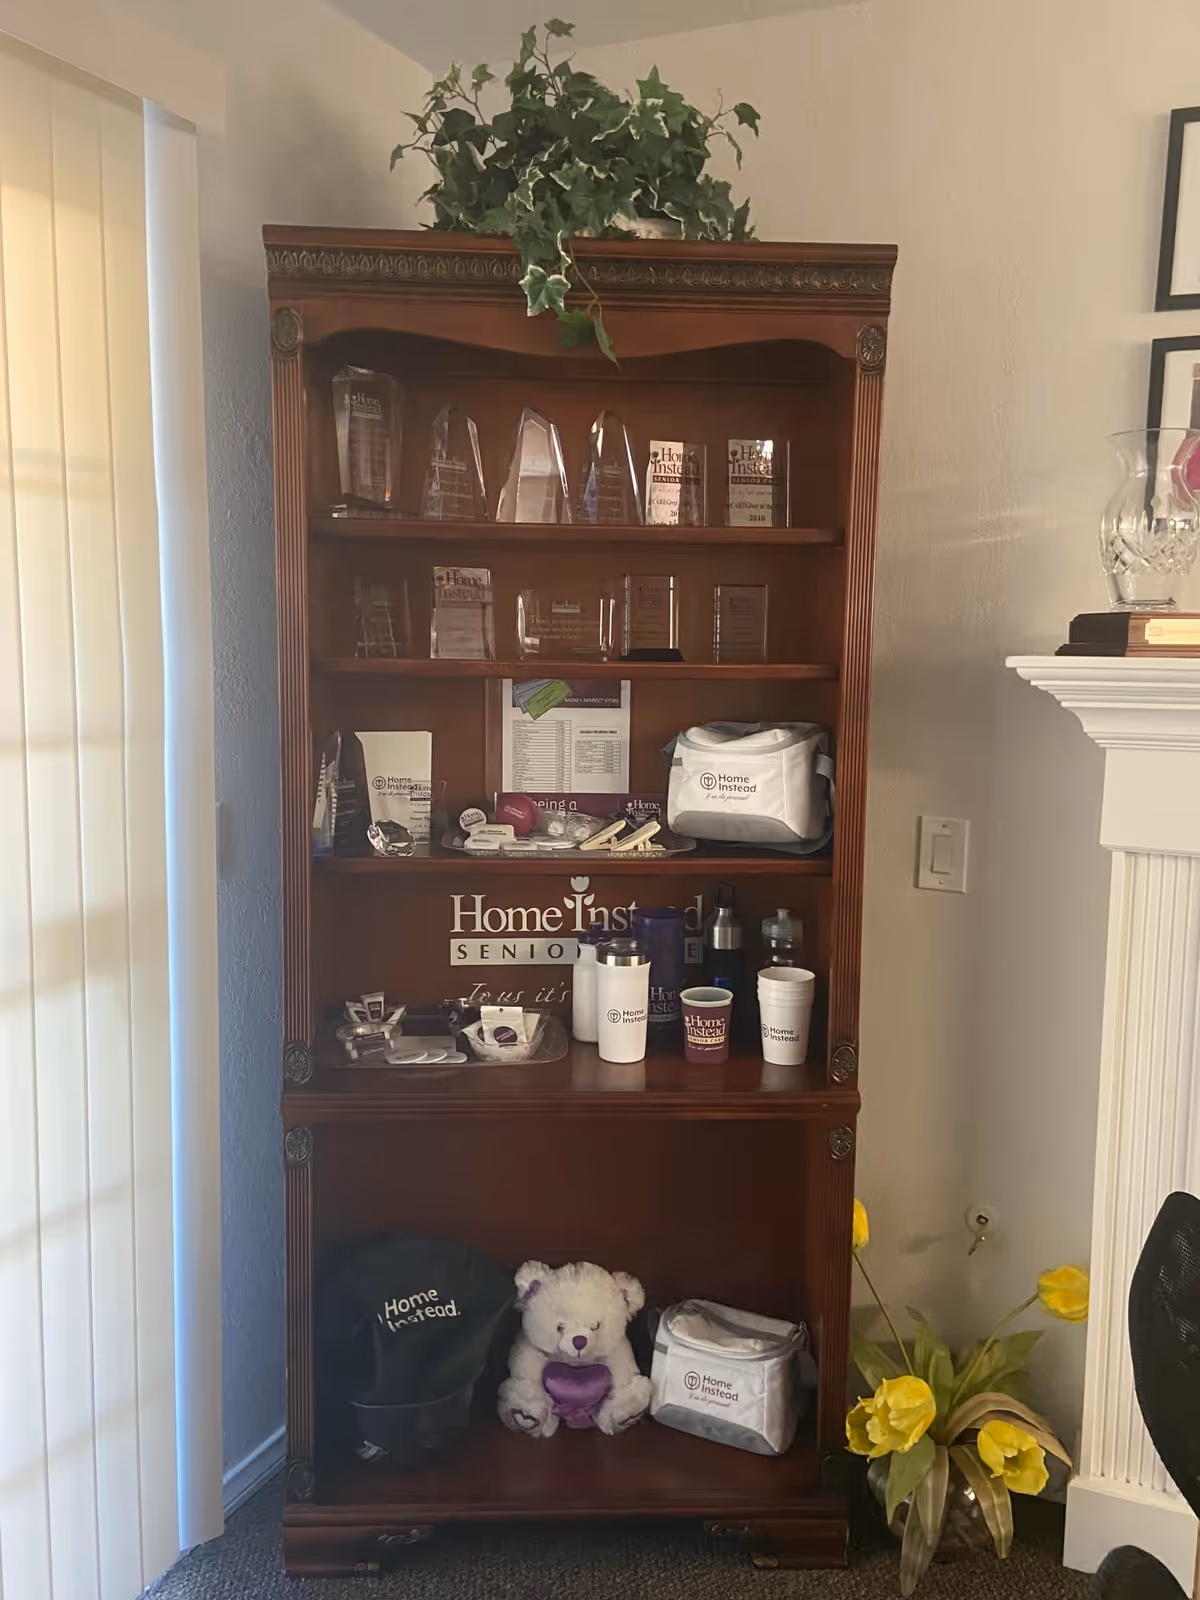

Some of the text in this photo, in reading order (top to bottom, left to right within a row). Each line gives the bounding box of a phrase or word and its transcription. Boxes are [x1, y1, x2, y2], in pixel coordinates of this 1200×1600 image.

[387, 776, 412, 784] Home
[718, 774, 750, 784] Home
[718, 783, 757, 793] Instead
[569, 801, 578, 811] a
[633, 799, 660, 809] Home
[450, 893, 703, 933] Home Instd
[457, 943, 581, 959] SENIO
[690, 1015, 725, 1027] Home
[686, 1023, 726, 1037] Instead
[770, 1027, 794, 1036] Home
[770, 1033, 800, 1042] Instead
[384, 1288, 439, 1319] Home
[702, 1375, 733, 1390] Home
[701, 1384, 739, 1401] Instead
